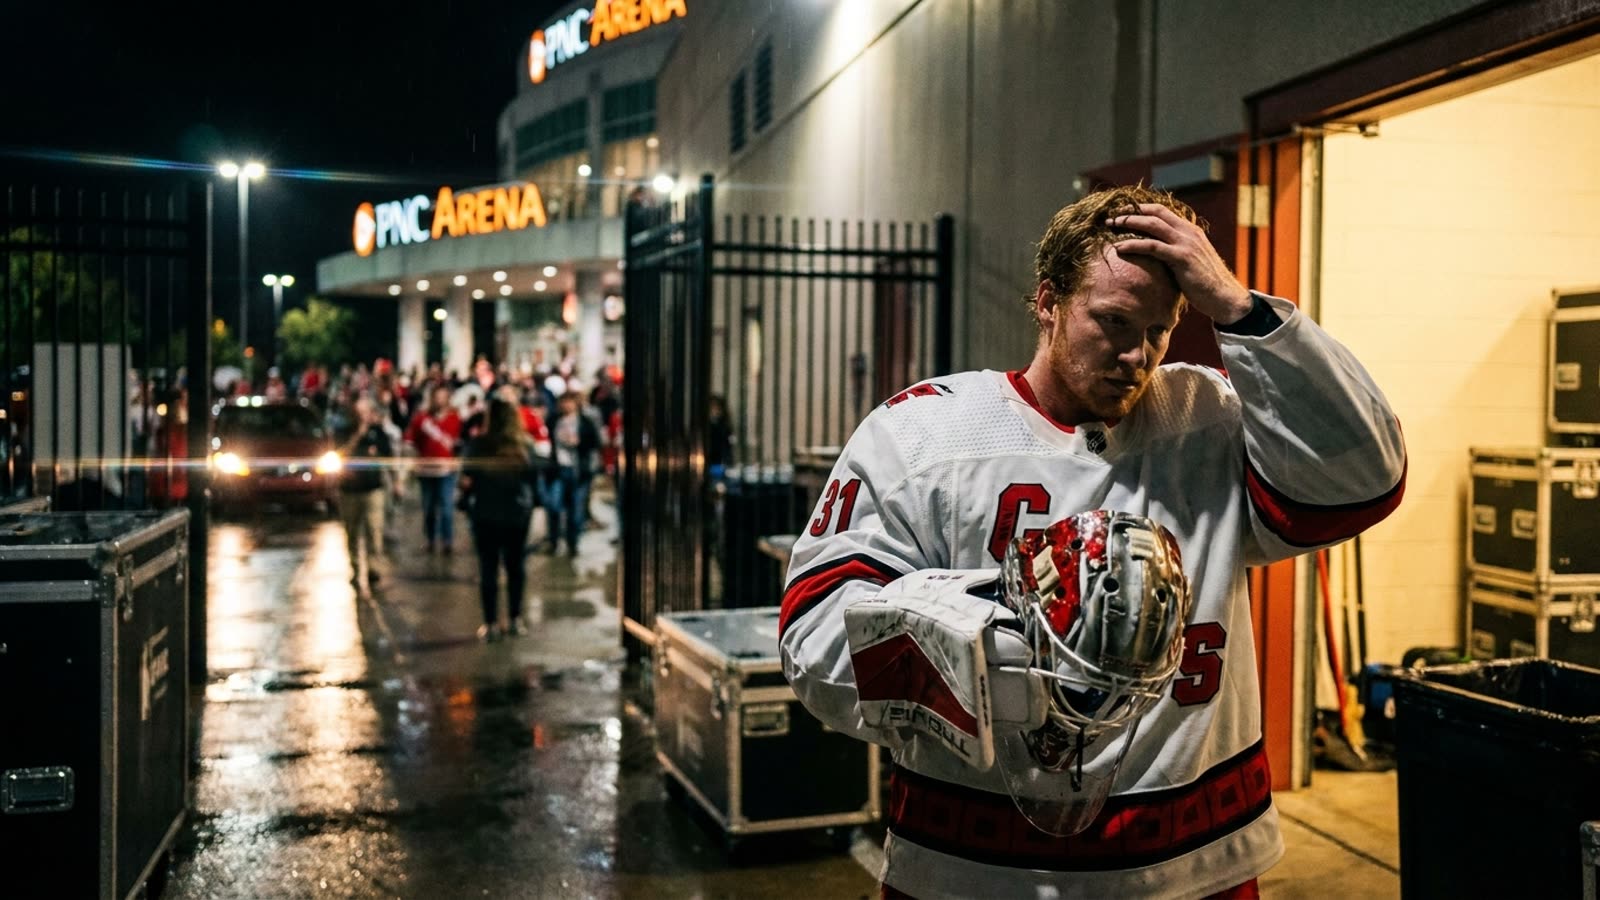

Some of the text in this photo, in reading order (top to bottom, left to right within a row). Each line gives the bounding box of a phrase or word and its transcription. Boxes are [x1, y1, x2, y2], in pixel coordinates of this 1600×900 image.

[544, 8, 590, 69] PNC
[375, 182, 547, 249] PNC ARENA
[810, 478, 862, 537] 31
